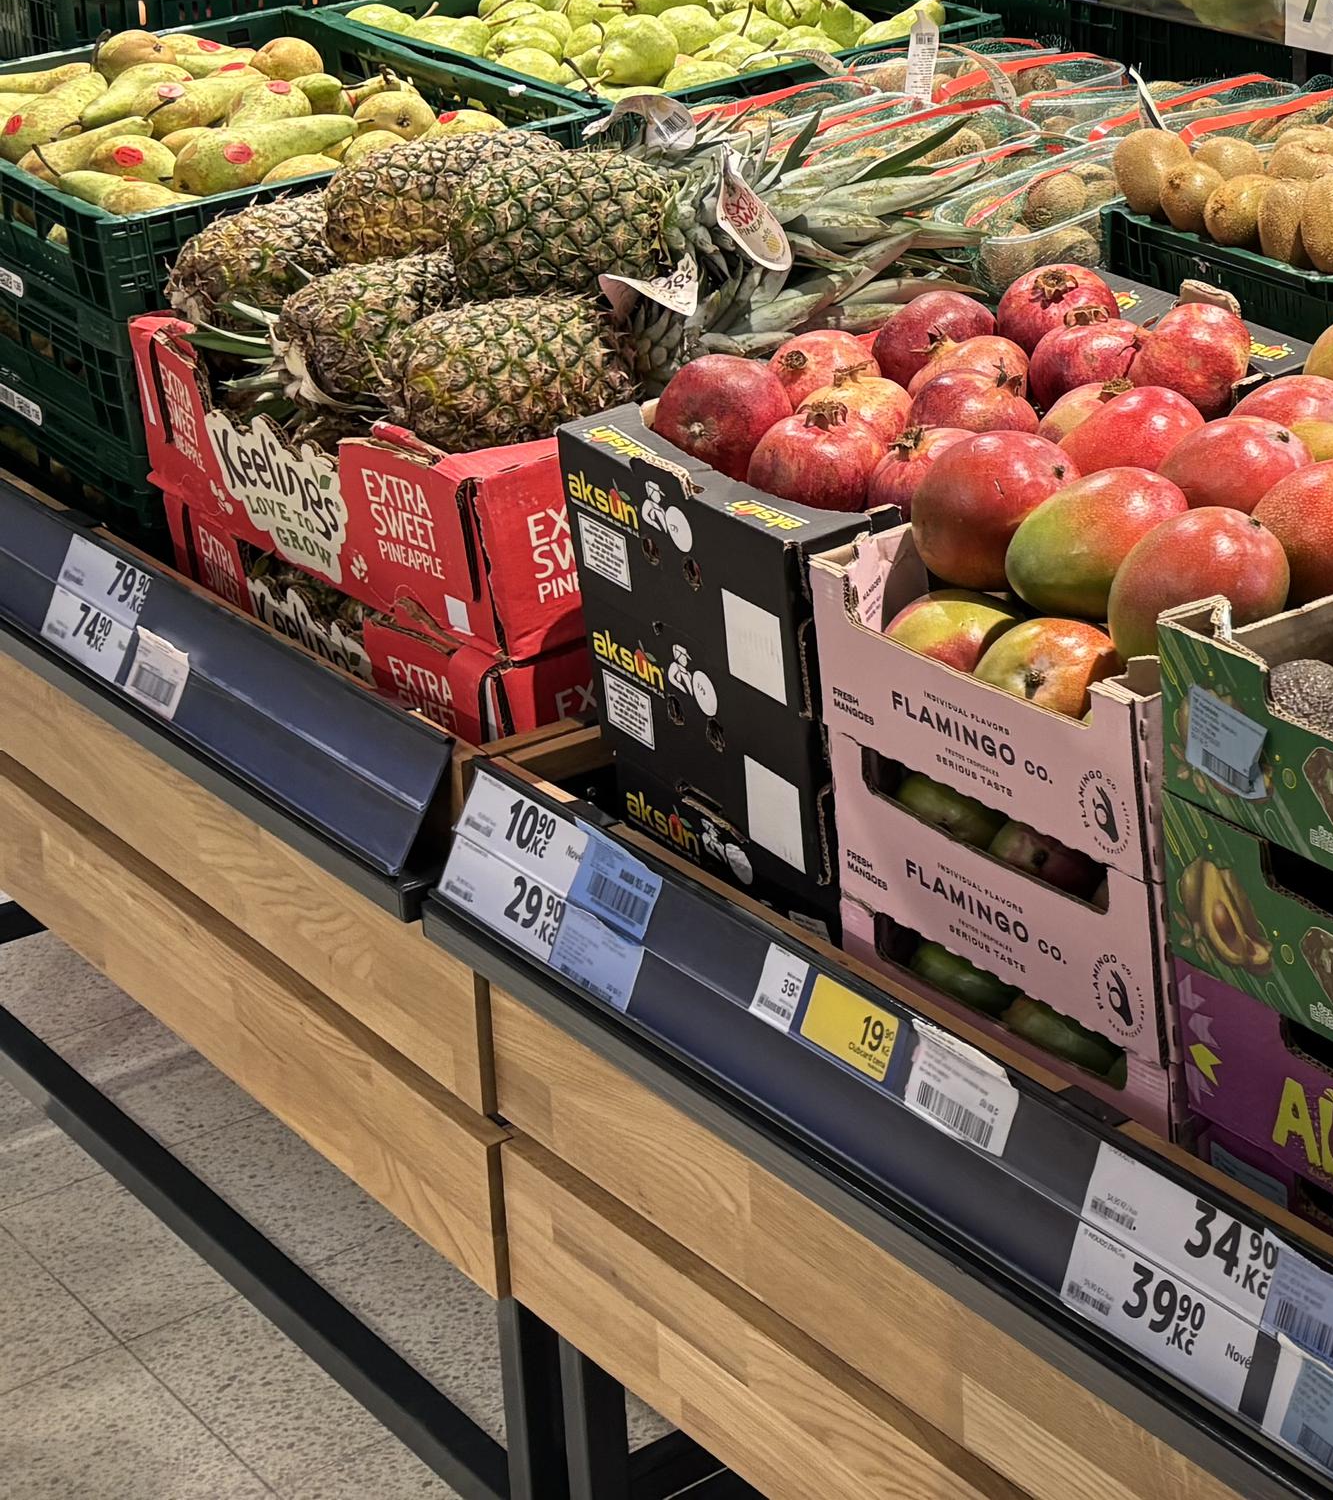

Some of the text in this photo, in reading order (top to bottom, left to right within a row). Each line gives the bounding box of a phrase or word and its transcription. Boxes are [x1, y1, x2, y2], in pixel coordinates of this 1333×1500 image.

[159, 362, 194, 411] EXTRA
[167, 397, 198, 447] SWEET
[248, 494, 316, 536] LOVE TO
[361, 467, 433, 520] EXTRA
[567, 470, 641, 531] aksun
[728, 499, 805, 532] aksun
[277, 526, 332, 570] GROW
[370, 503, 436, 553] SWEET
[528, 504, 571, 548] EX
[198, 523, 237, 578] EXTRA
[378, 538, 446, 581] PINEAPPLE
[106, 559, 136, 604] 79
[71, 602, 97, 647] 74
[592, 629, 665, 691] aksun
[832, 685, 860, 707] FRESH
[833, 698, 875, 726] MANGOES
[922, 690, 1010, 736] INDIVIDUAL FLAVORS
[891, 689, 1055, 785] FLAMINGO CO.
[936, 753, 1014, 798] SERIOUS TASTE
[505, 798, 556, 850] 10 90
[625, 790, 701, 856] aksun
[846, 849, 873, 872] FRESH
[847, 861, 889, 892] MANGOES
[504, 875, 544, 930] 29
[546, 895, 563, 925] 90
[905, 857, 1068, 966] FLAMINGO CO.
[937, 862, 1024, 915] INDIVIDUAL FLAVORS
[948, 924, 1027, 974] SERIOUS TASTE
[781, 978, 796, 998] 39
[848, 1041, 873, 1065] Clubcard
[860, 1014, 885, 1052] 19
[1184, 1198, 1279, 1278] 34 90
[1121, 1261, 1206, 1334] 39 90
